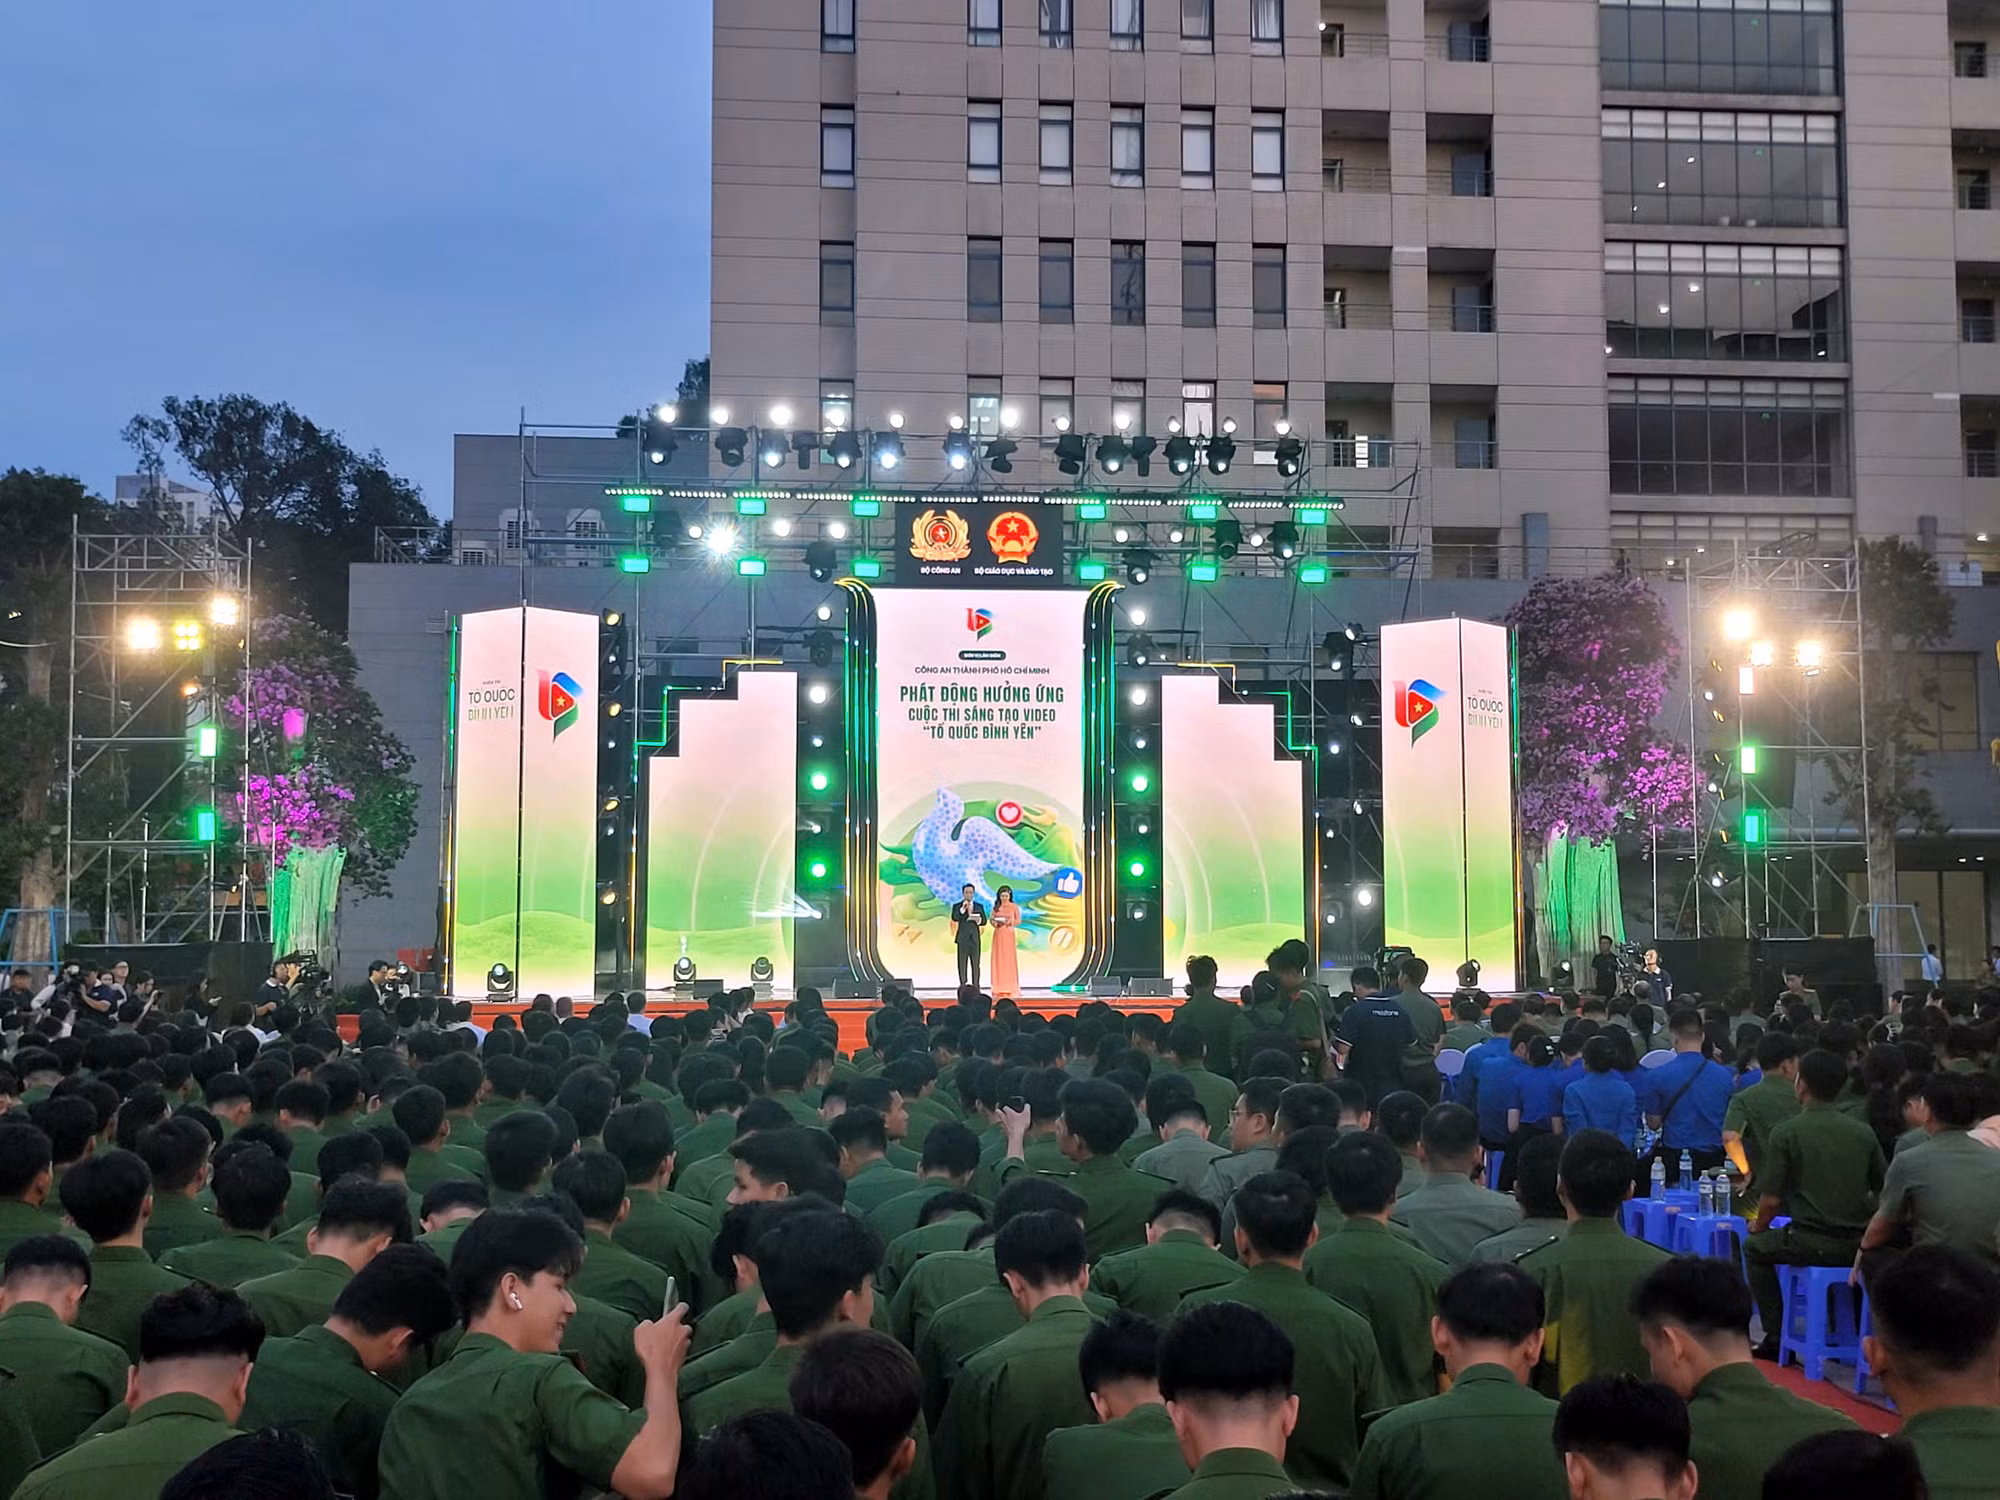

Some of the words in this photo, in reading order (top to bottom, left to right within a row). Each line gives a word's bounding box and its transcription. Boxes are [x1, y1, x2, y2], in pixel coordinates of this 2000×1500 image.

[915, 666, 938, 674] CÔNG
[900, 682, 935, 702] PHÁT
[940, 682, 978, 706] ĐỘNG
[984, 680, 1030, 702] HƯỞNG
[1036, 684, 1064, 702] ỨNG
[908, 704, 938, 724] CUỘC
[943, 708, 960, 721] THI
[964, 706, 994, 721] SÁNG
[998, 708, 1019, 724] TẠO
[1024, 708, 1056, 721] VIDEO
[949, 723, 978, 740] QUỐC
[983, 723, 1009, 739] BÌNH
